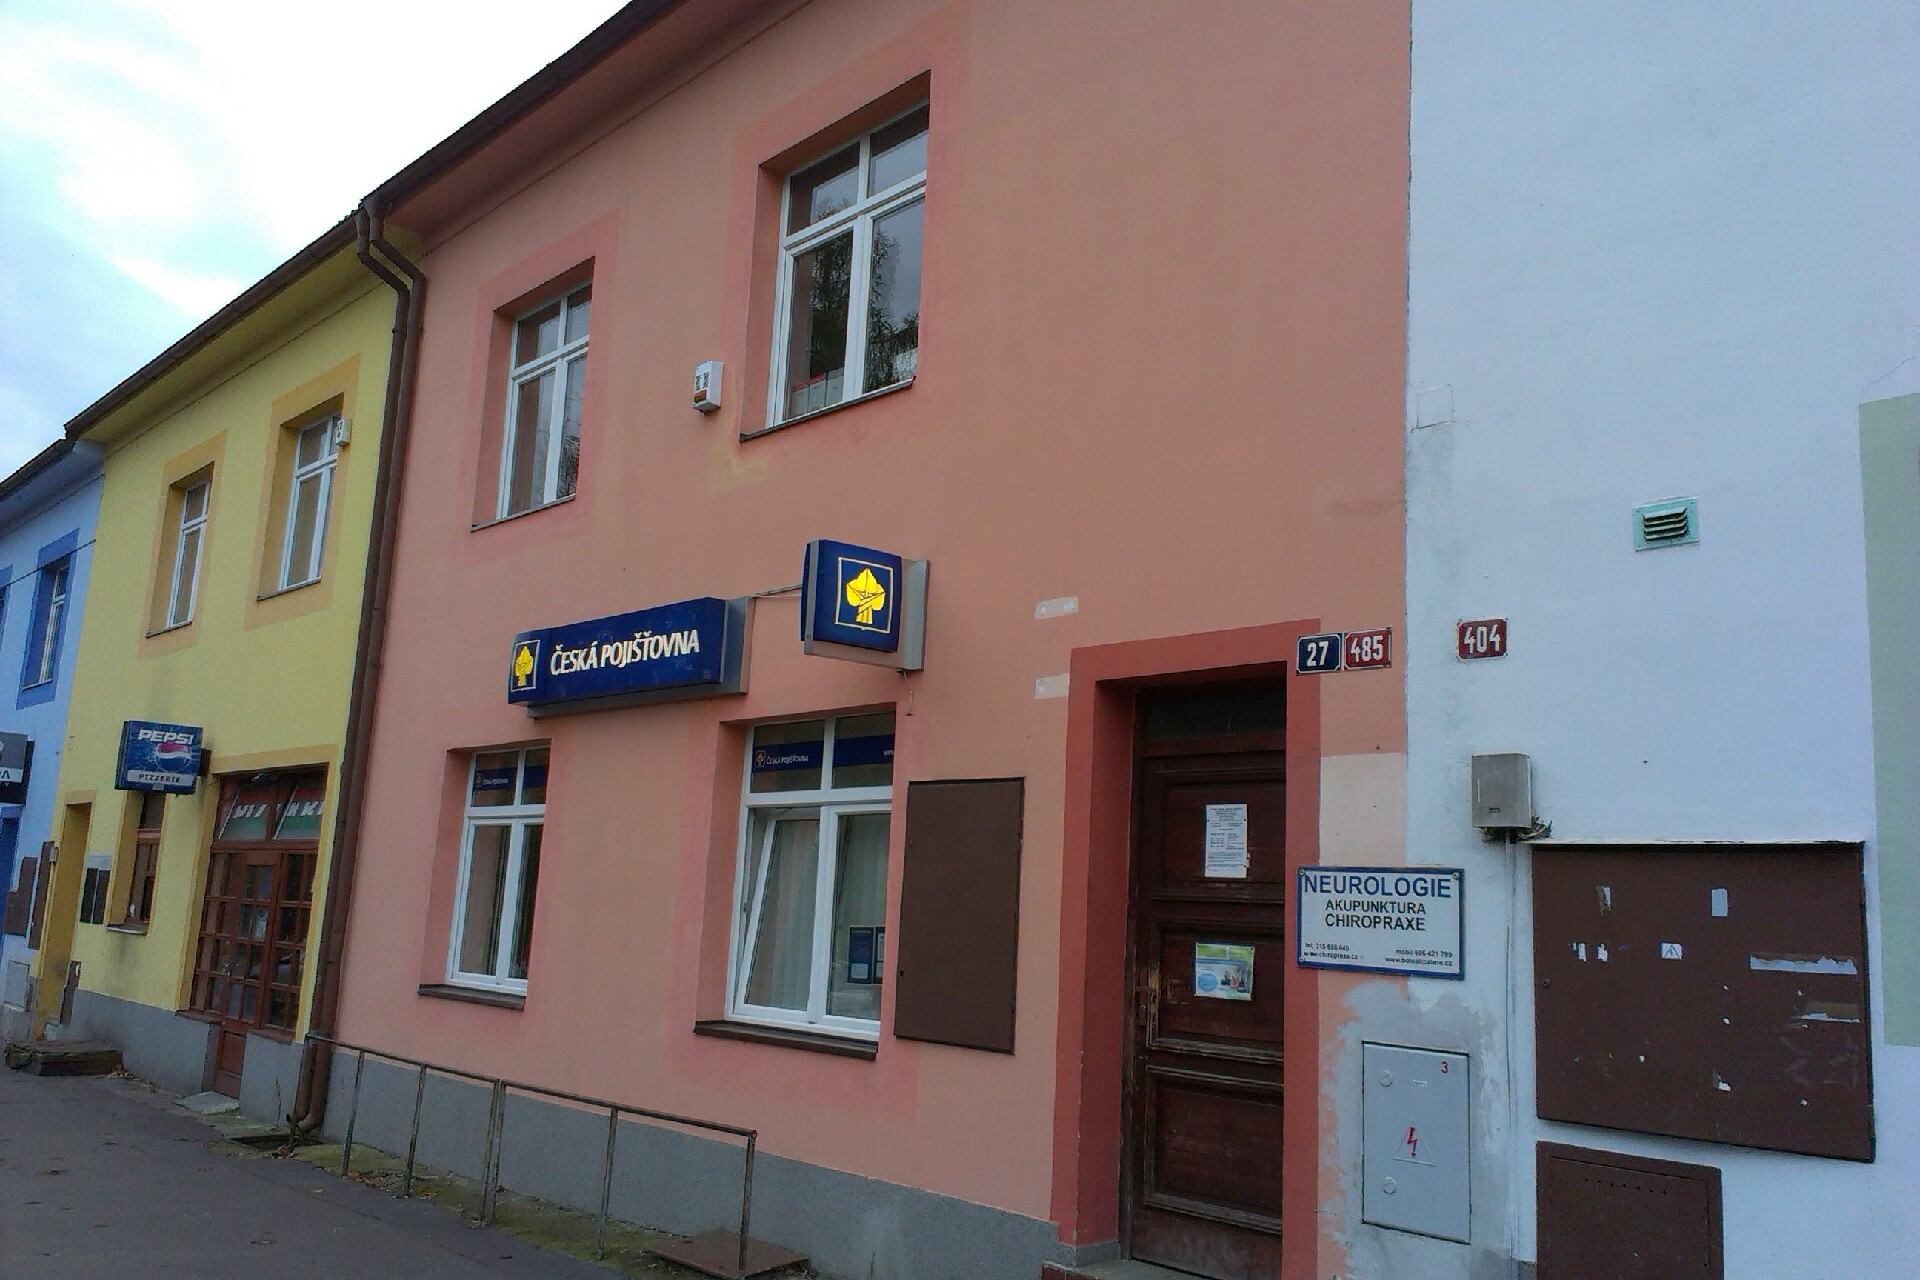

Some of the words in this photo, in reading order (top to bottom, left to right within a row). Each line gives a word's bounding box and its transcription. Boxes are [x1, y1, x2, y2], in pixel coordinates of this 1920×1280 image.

[1350, 633, 1385, 663] 485
[1463, 624, 1501, 654] 404
[550, 640, 598, 676] ČESKÁ
[600, 629, 700, 668] POJIŠŤOVNA
[1306, 640, 1329, 667] 27
[138, 729, 195, 745] PEPSI
[138, 773, 181, 784] PIZZERIE
[1304, 873, 1451, 898] NEUROLOGIE
[1325, 899, 1427, 915] AKUPUNKTURA
[1325, 913, 1426, 931] CHIROPRAXE
[1441, 1061, 1449, 1074] 3
